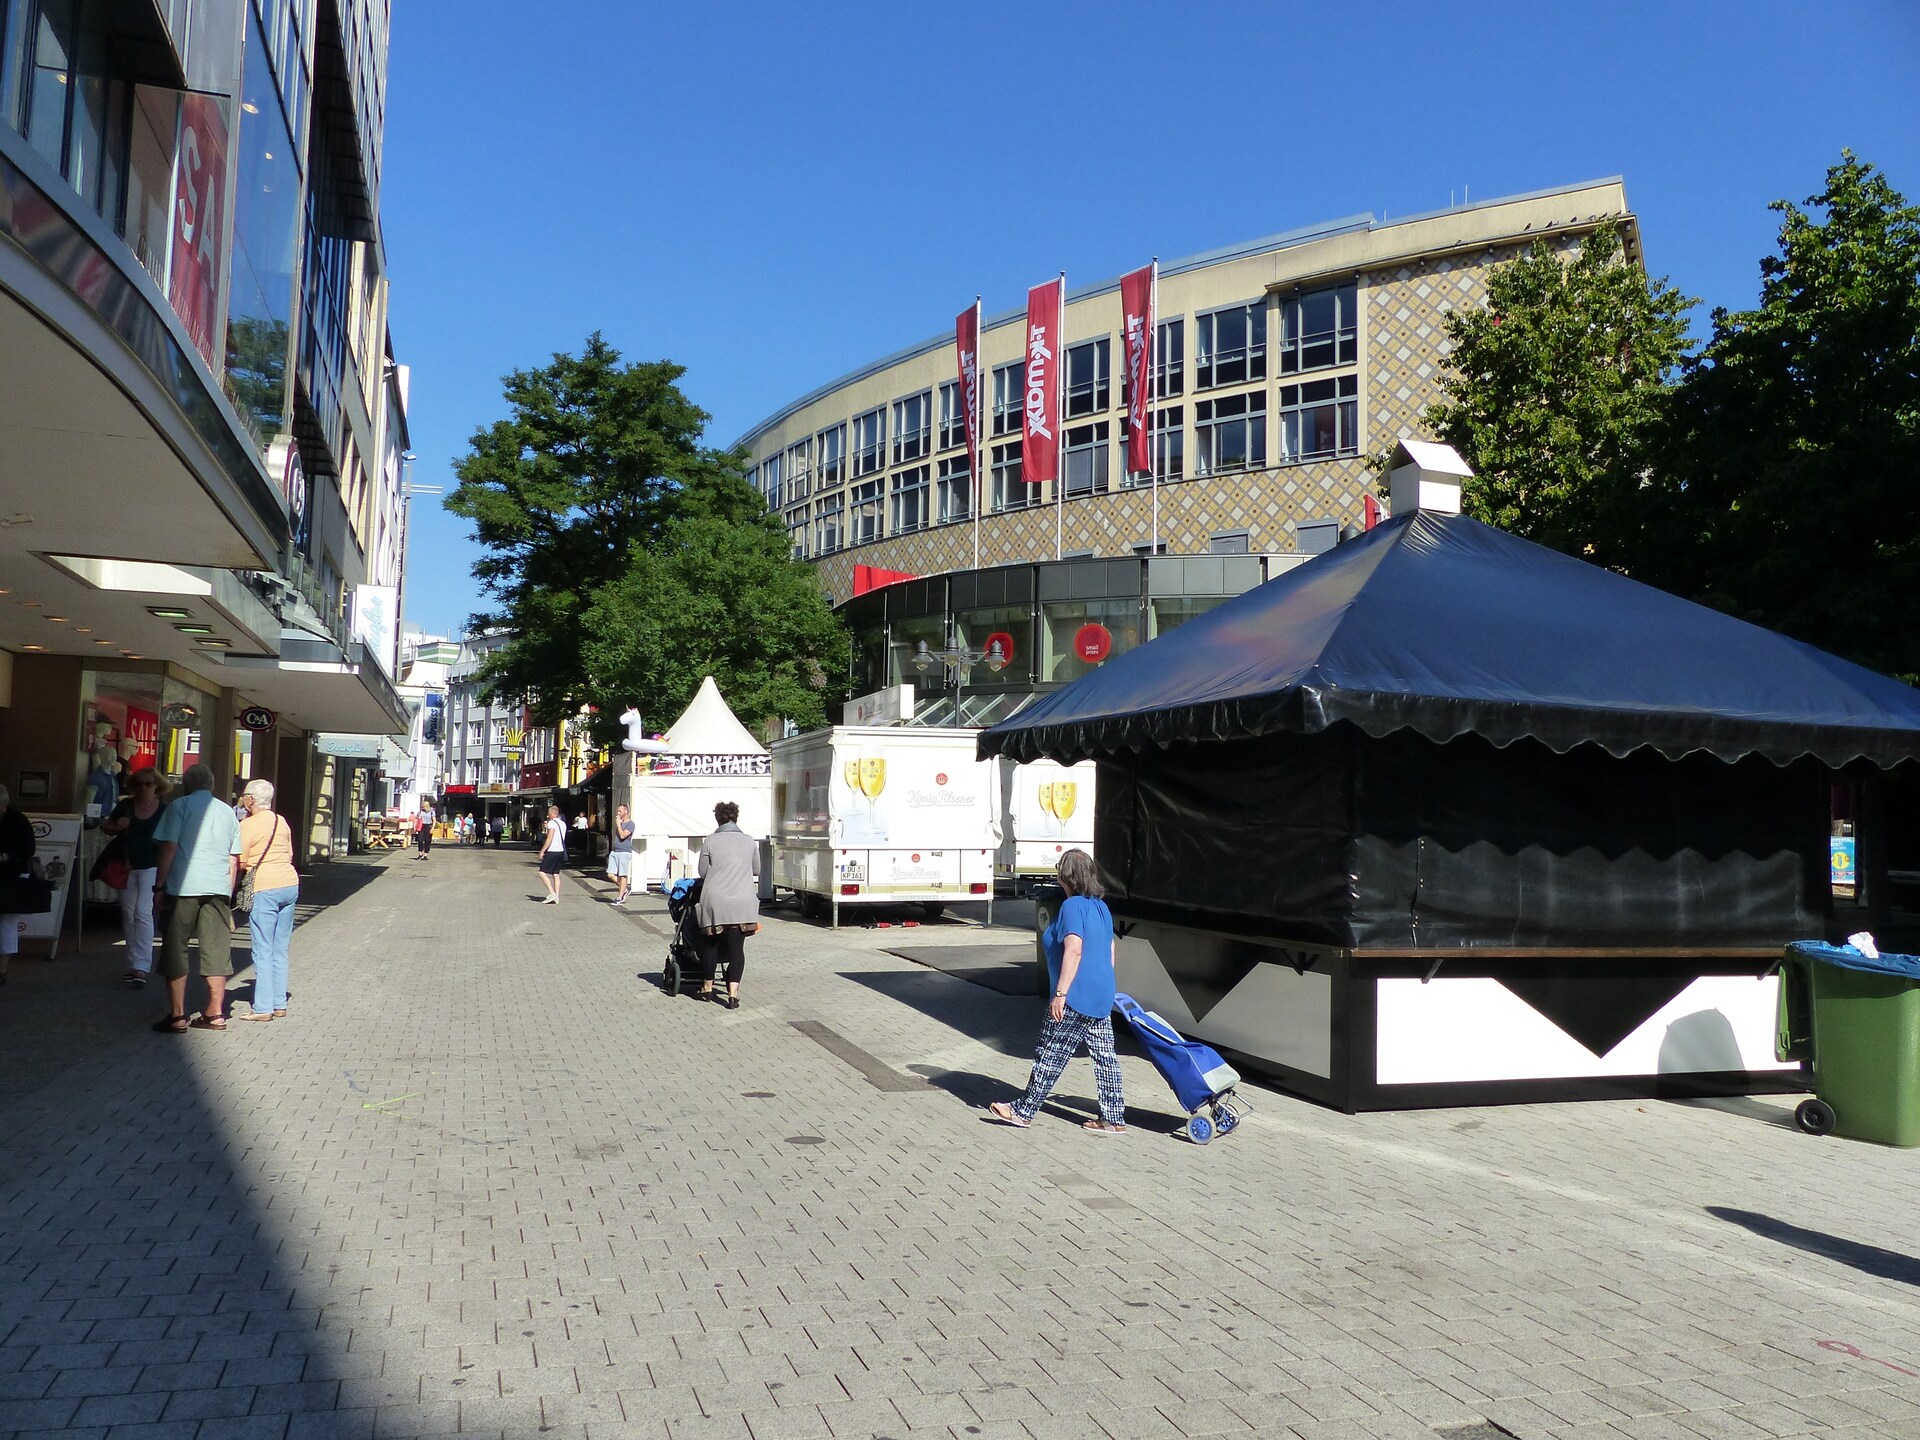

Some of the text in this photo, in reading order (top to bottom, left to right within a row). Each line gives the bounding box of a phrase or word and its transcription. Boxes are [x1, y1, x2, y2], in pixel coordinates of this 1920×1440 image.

[246, 713, 268, 725] C&A
[131, 718, 157, 755] SALE
[681, 755, 767, 774] COCKTAILS
[938, 789, 976, 805] Pilsener
